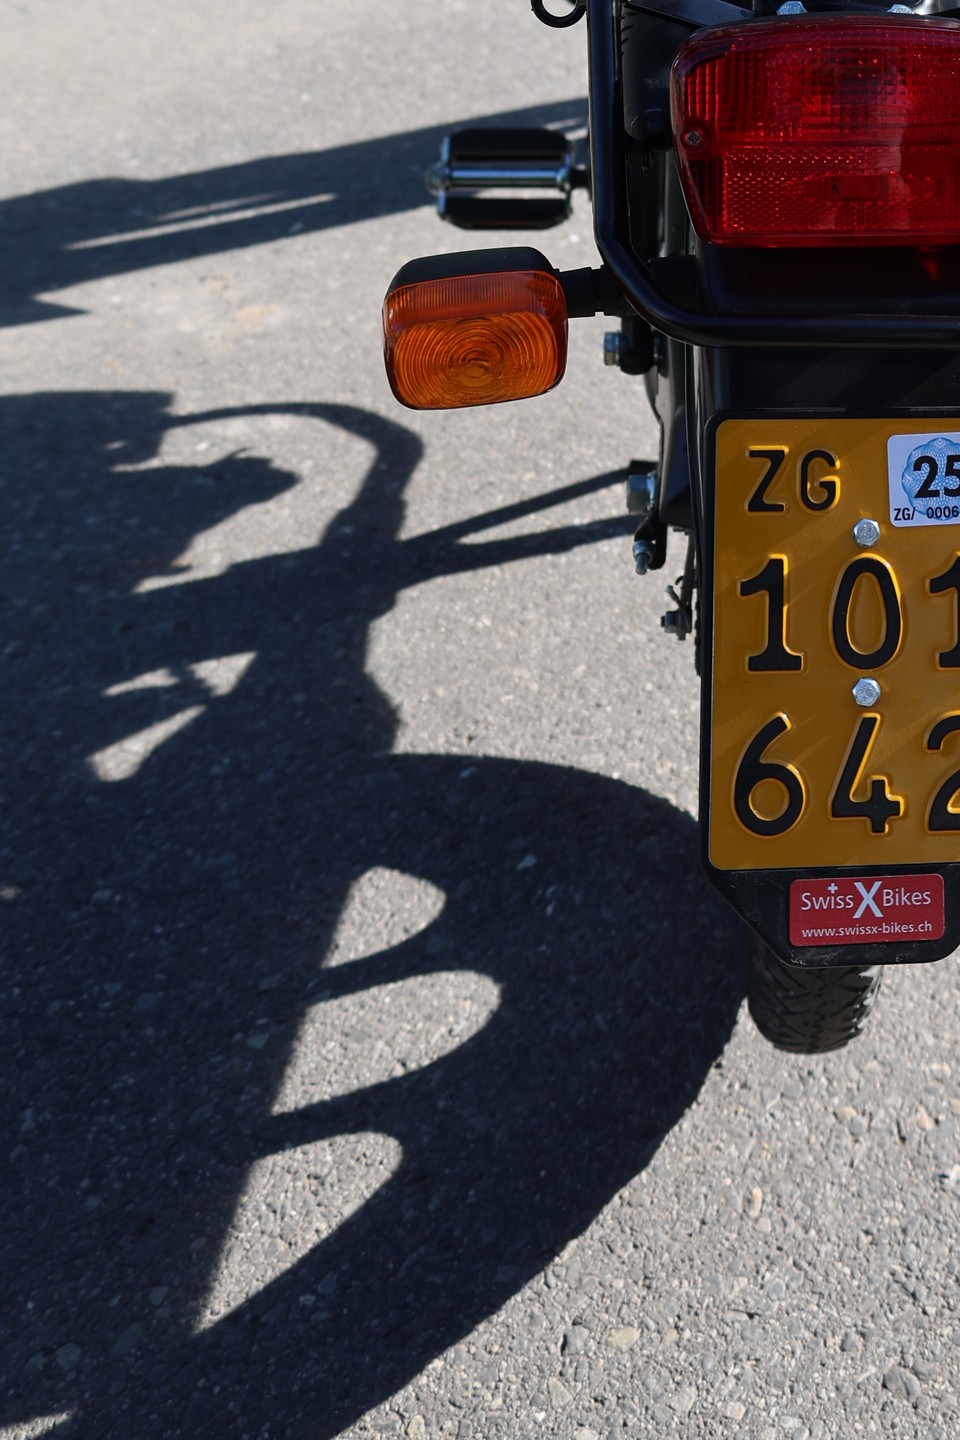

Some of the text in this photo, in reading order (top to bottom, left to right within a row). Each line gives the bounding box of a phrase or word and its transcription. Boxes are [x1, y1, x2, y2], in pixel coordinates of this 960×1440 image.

[747, 446, 841, 512] ZG
[893, 507, 916, 521] ZG/
[801, 920, 933, 938] www.swissx-bikes.ch
